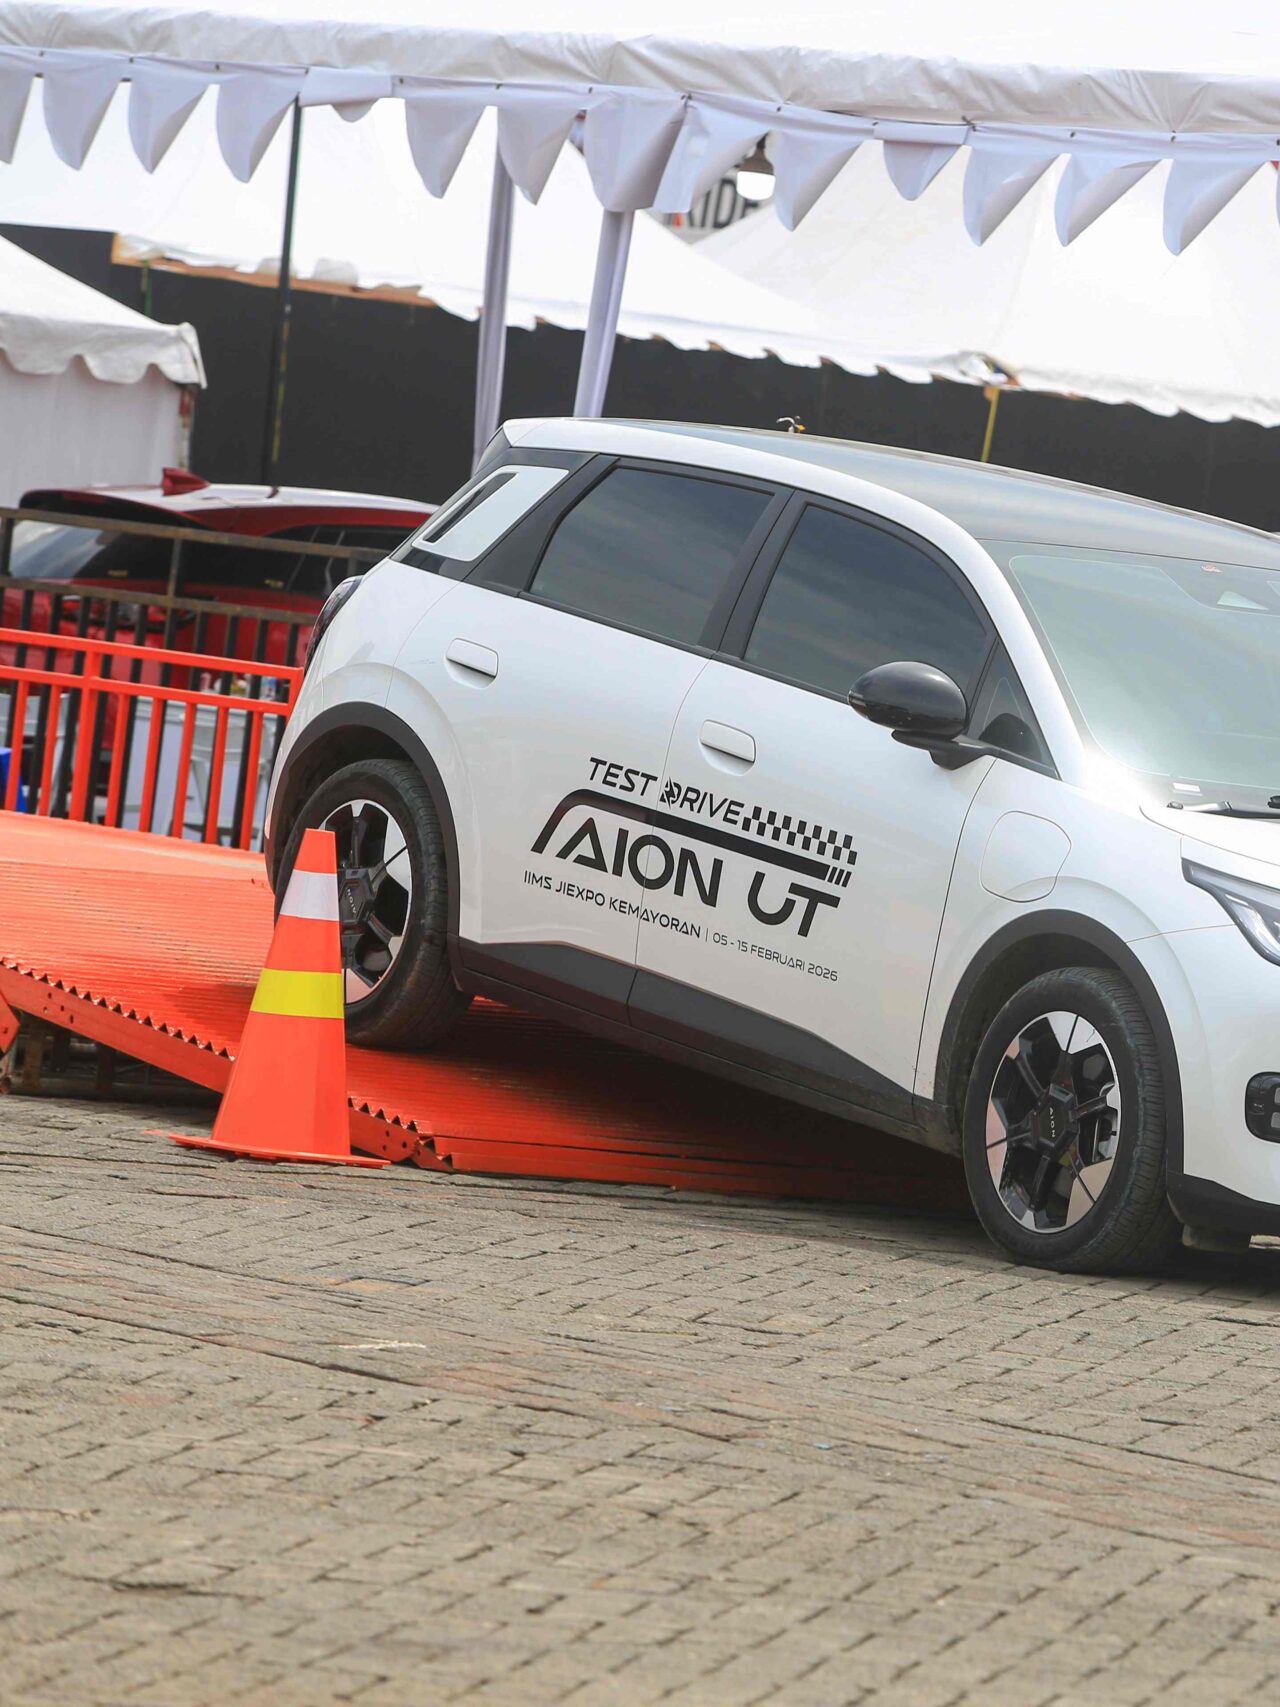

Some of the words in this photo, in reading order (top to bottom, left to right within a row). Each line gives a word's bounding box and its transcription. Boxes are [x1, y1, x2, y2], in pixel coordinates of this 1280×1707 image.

[589, 757, 657, 796] TEST
[659, 777, 744, 826] DRIVE
[524, 870, 553, 890] IIMS
[555, 880, 606, 907] JIEXPO
[609, 896, 701, 939] KEMAYORAN
[712, 932, 728, 946] 05
[737, 939, 749, 953] 15
[750, 944, 806, 972] FEBRUARI
[807, 963, 839, 981] 2026
[555, 817, 723, 908] AION
[748, 871, 840, 937] UT
